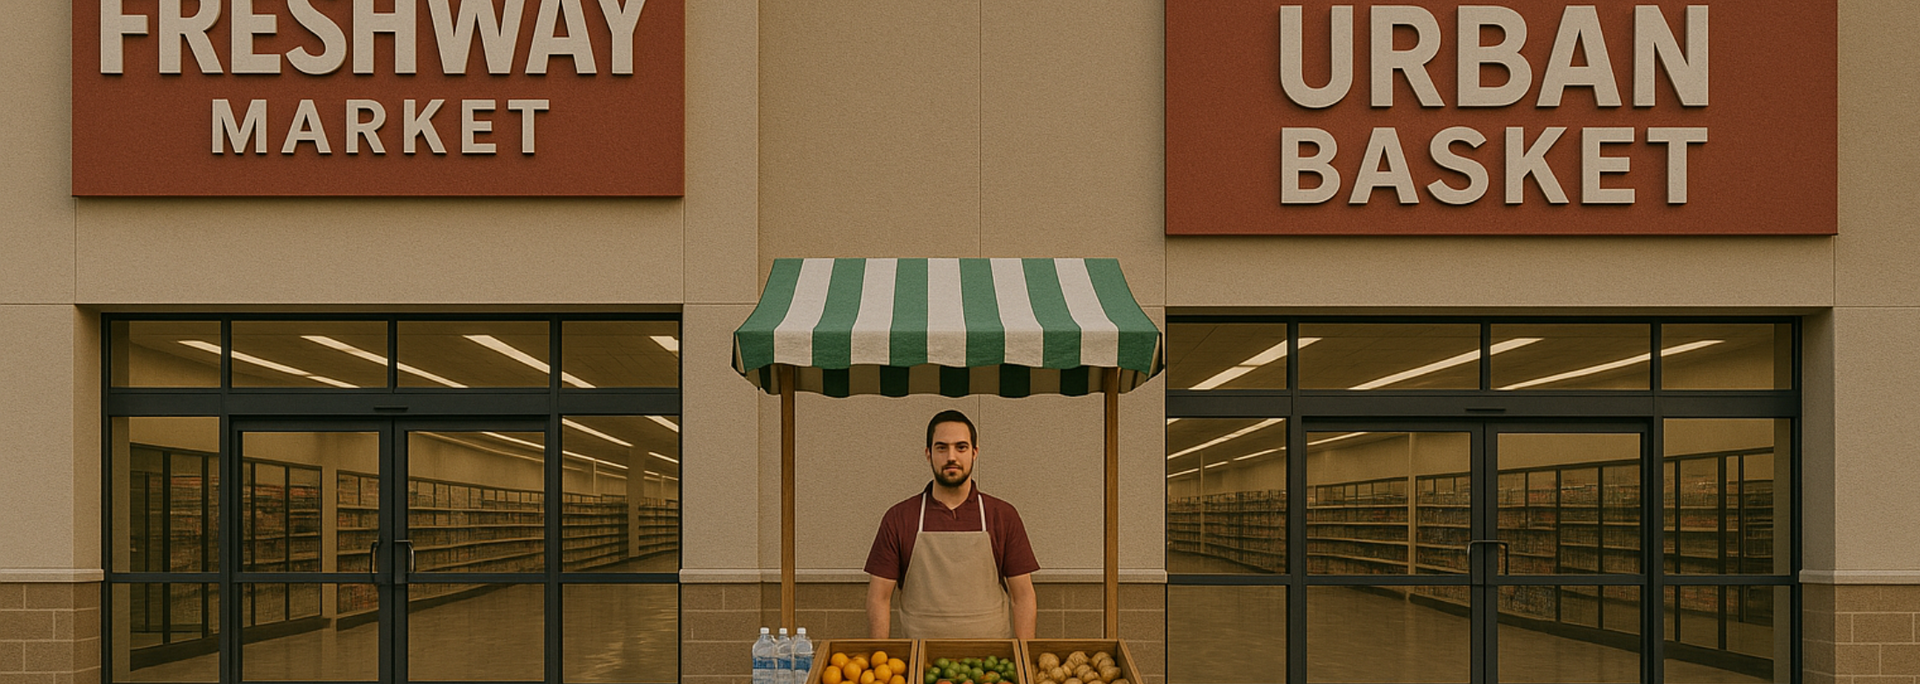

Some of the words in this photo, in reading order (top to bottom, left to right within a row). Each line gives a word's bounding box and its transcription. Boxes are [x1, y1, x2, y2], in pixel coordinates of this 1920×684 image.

[100, 0, 647, 75] FRESHWAY
[1279, 5, 1709, 108] URBAN
[211, 99, 550, 154] MARKET
[1280, 126, 1709, 205] BASKET
